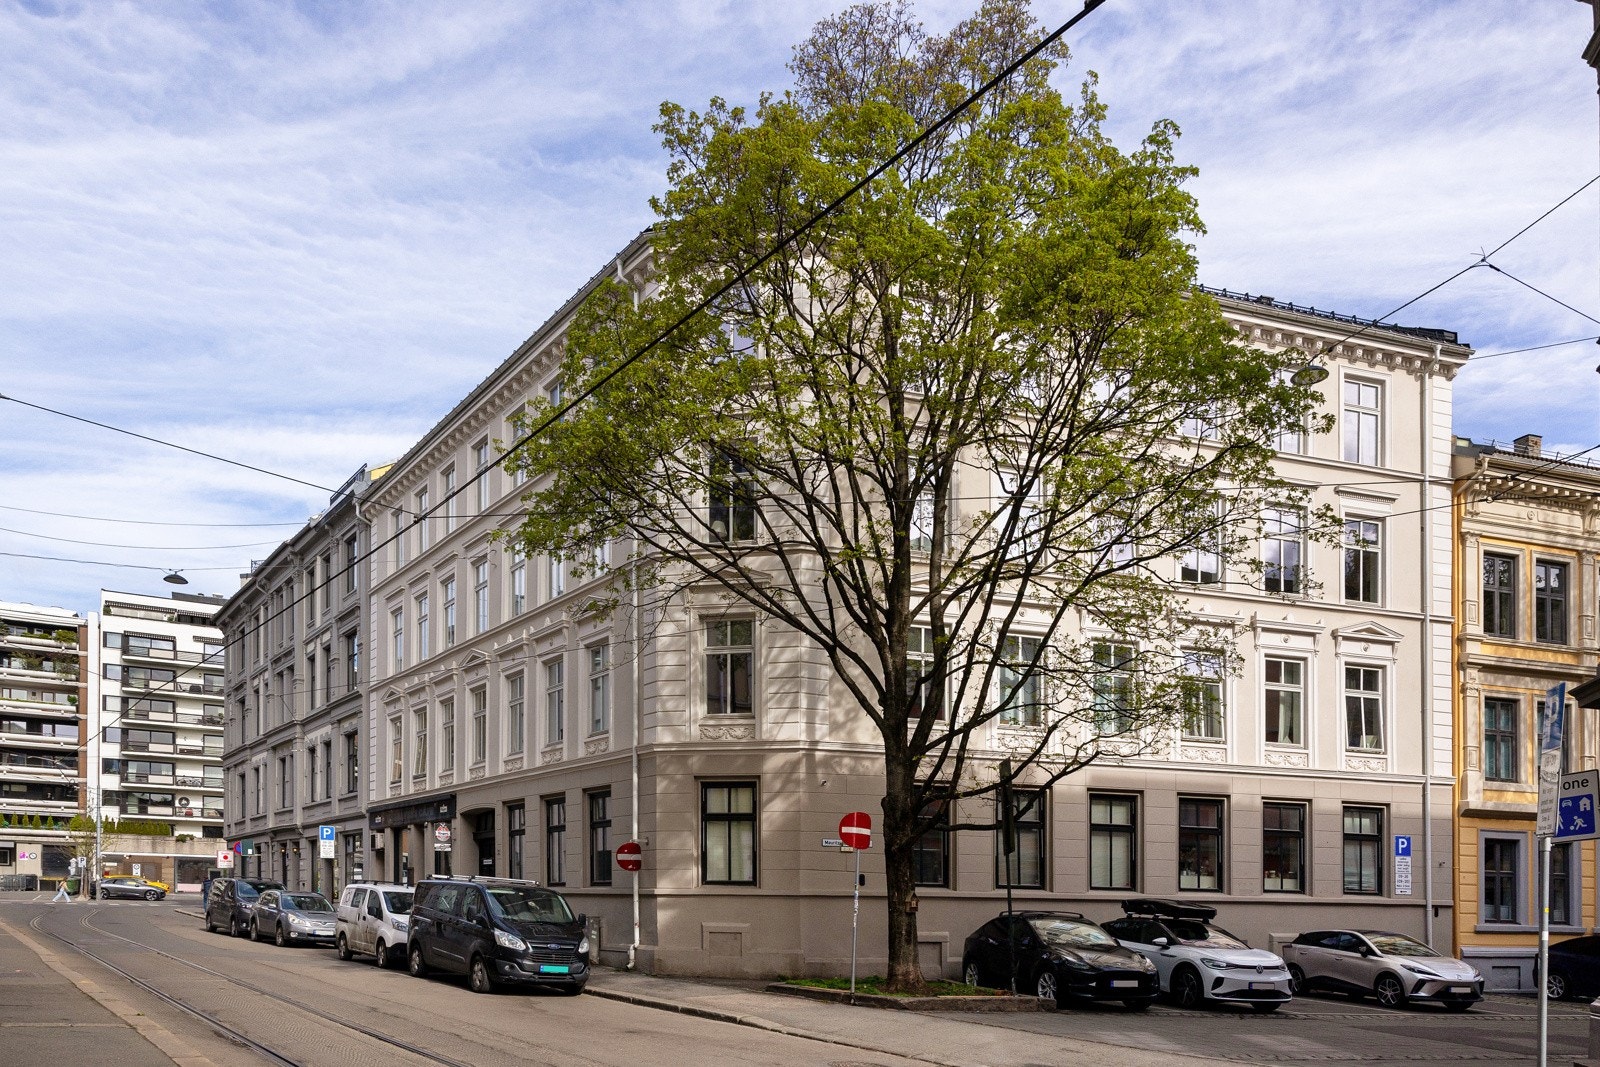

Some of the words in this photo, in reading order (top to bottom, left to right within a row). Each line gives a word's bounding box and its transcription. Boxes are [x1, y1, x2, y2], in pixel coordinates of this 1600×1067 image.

[1547, 694, 1559, 742] P
[1562, 778, 1589, 791] one
[323, 828, 331, 839] P
[1398, 838, 1408, 854] P
